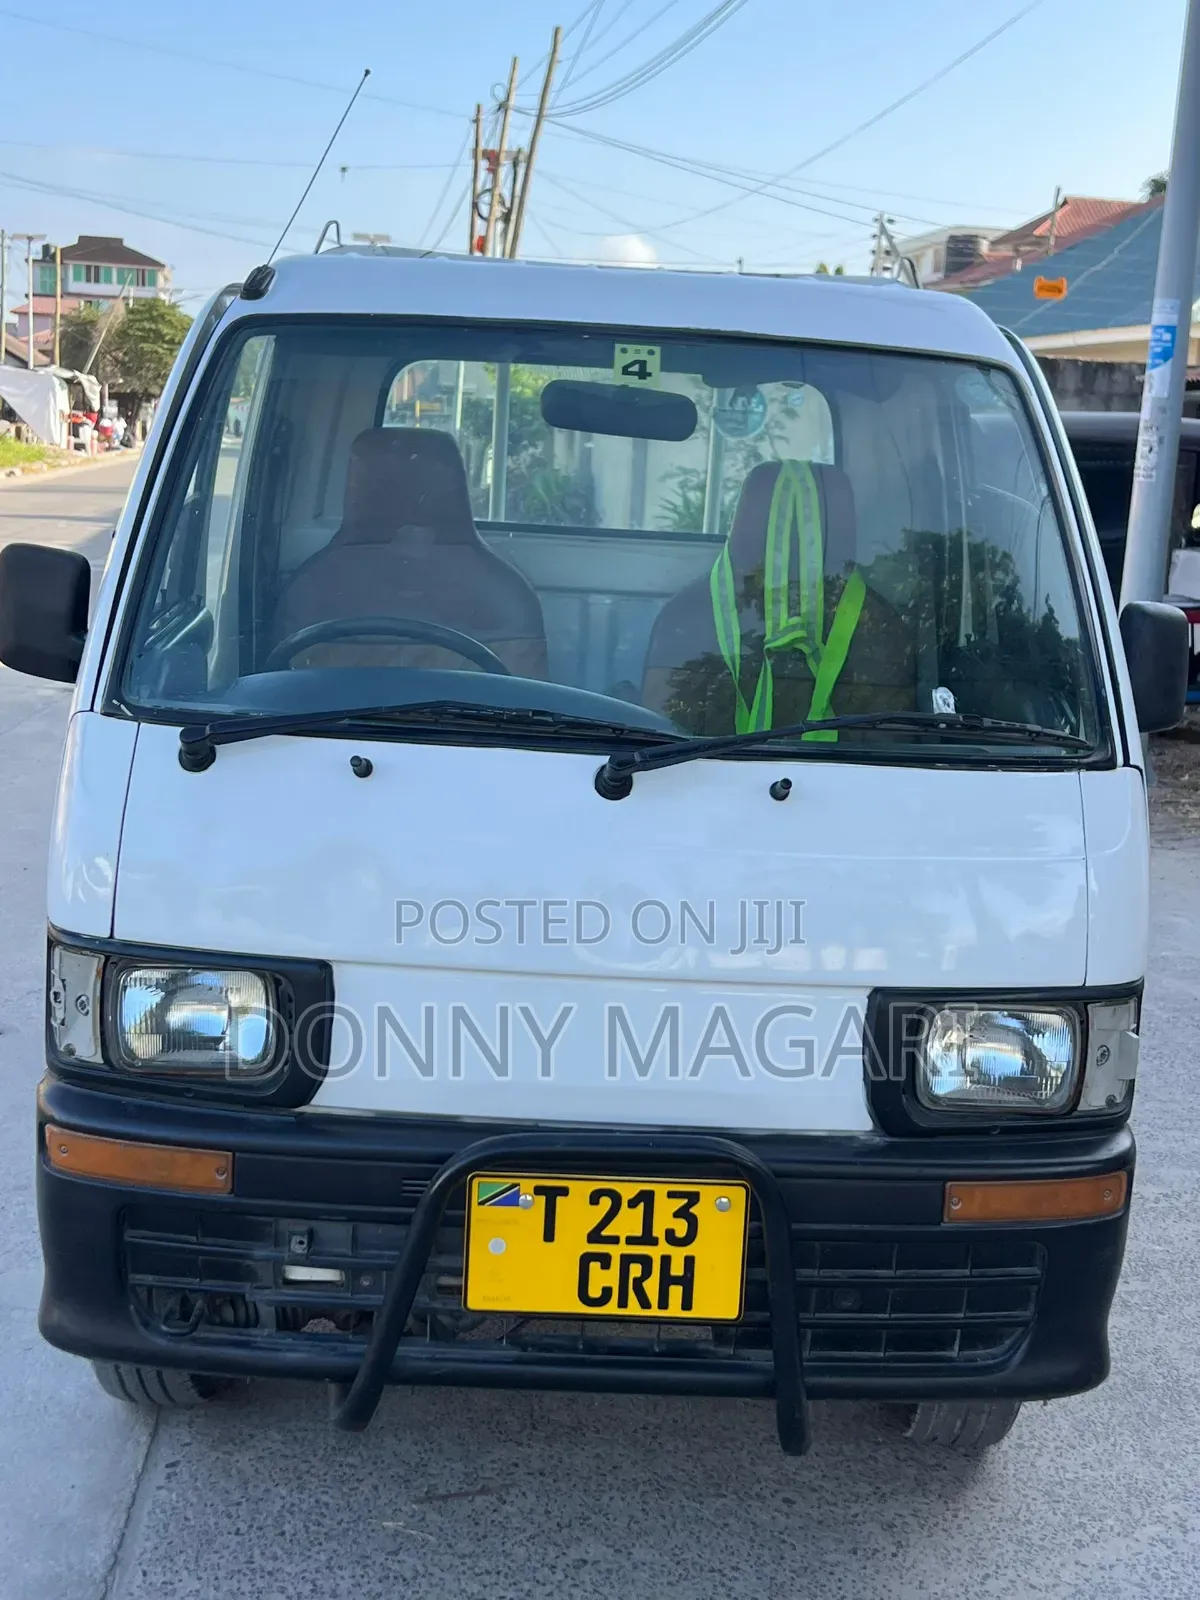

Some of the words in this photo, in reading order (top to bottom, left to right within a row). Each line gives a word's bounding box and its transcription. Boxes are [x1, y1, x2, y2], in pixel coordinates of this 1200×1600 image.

[621, 359, 652, 380] 4
[533, 1185, 569, 1243] T
[586, 1188, 700, 1247] 213
[577, 1251, 695, 1311] CRH
